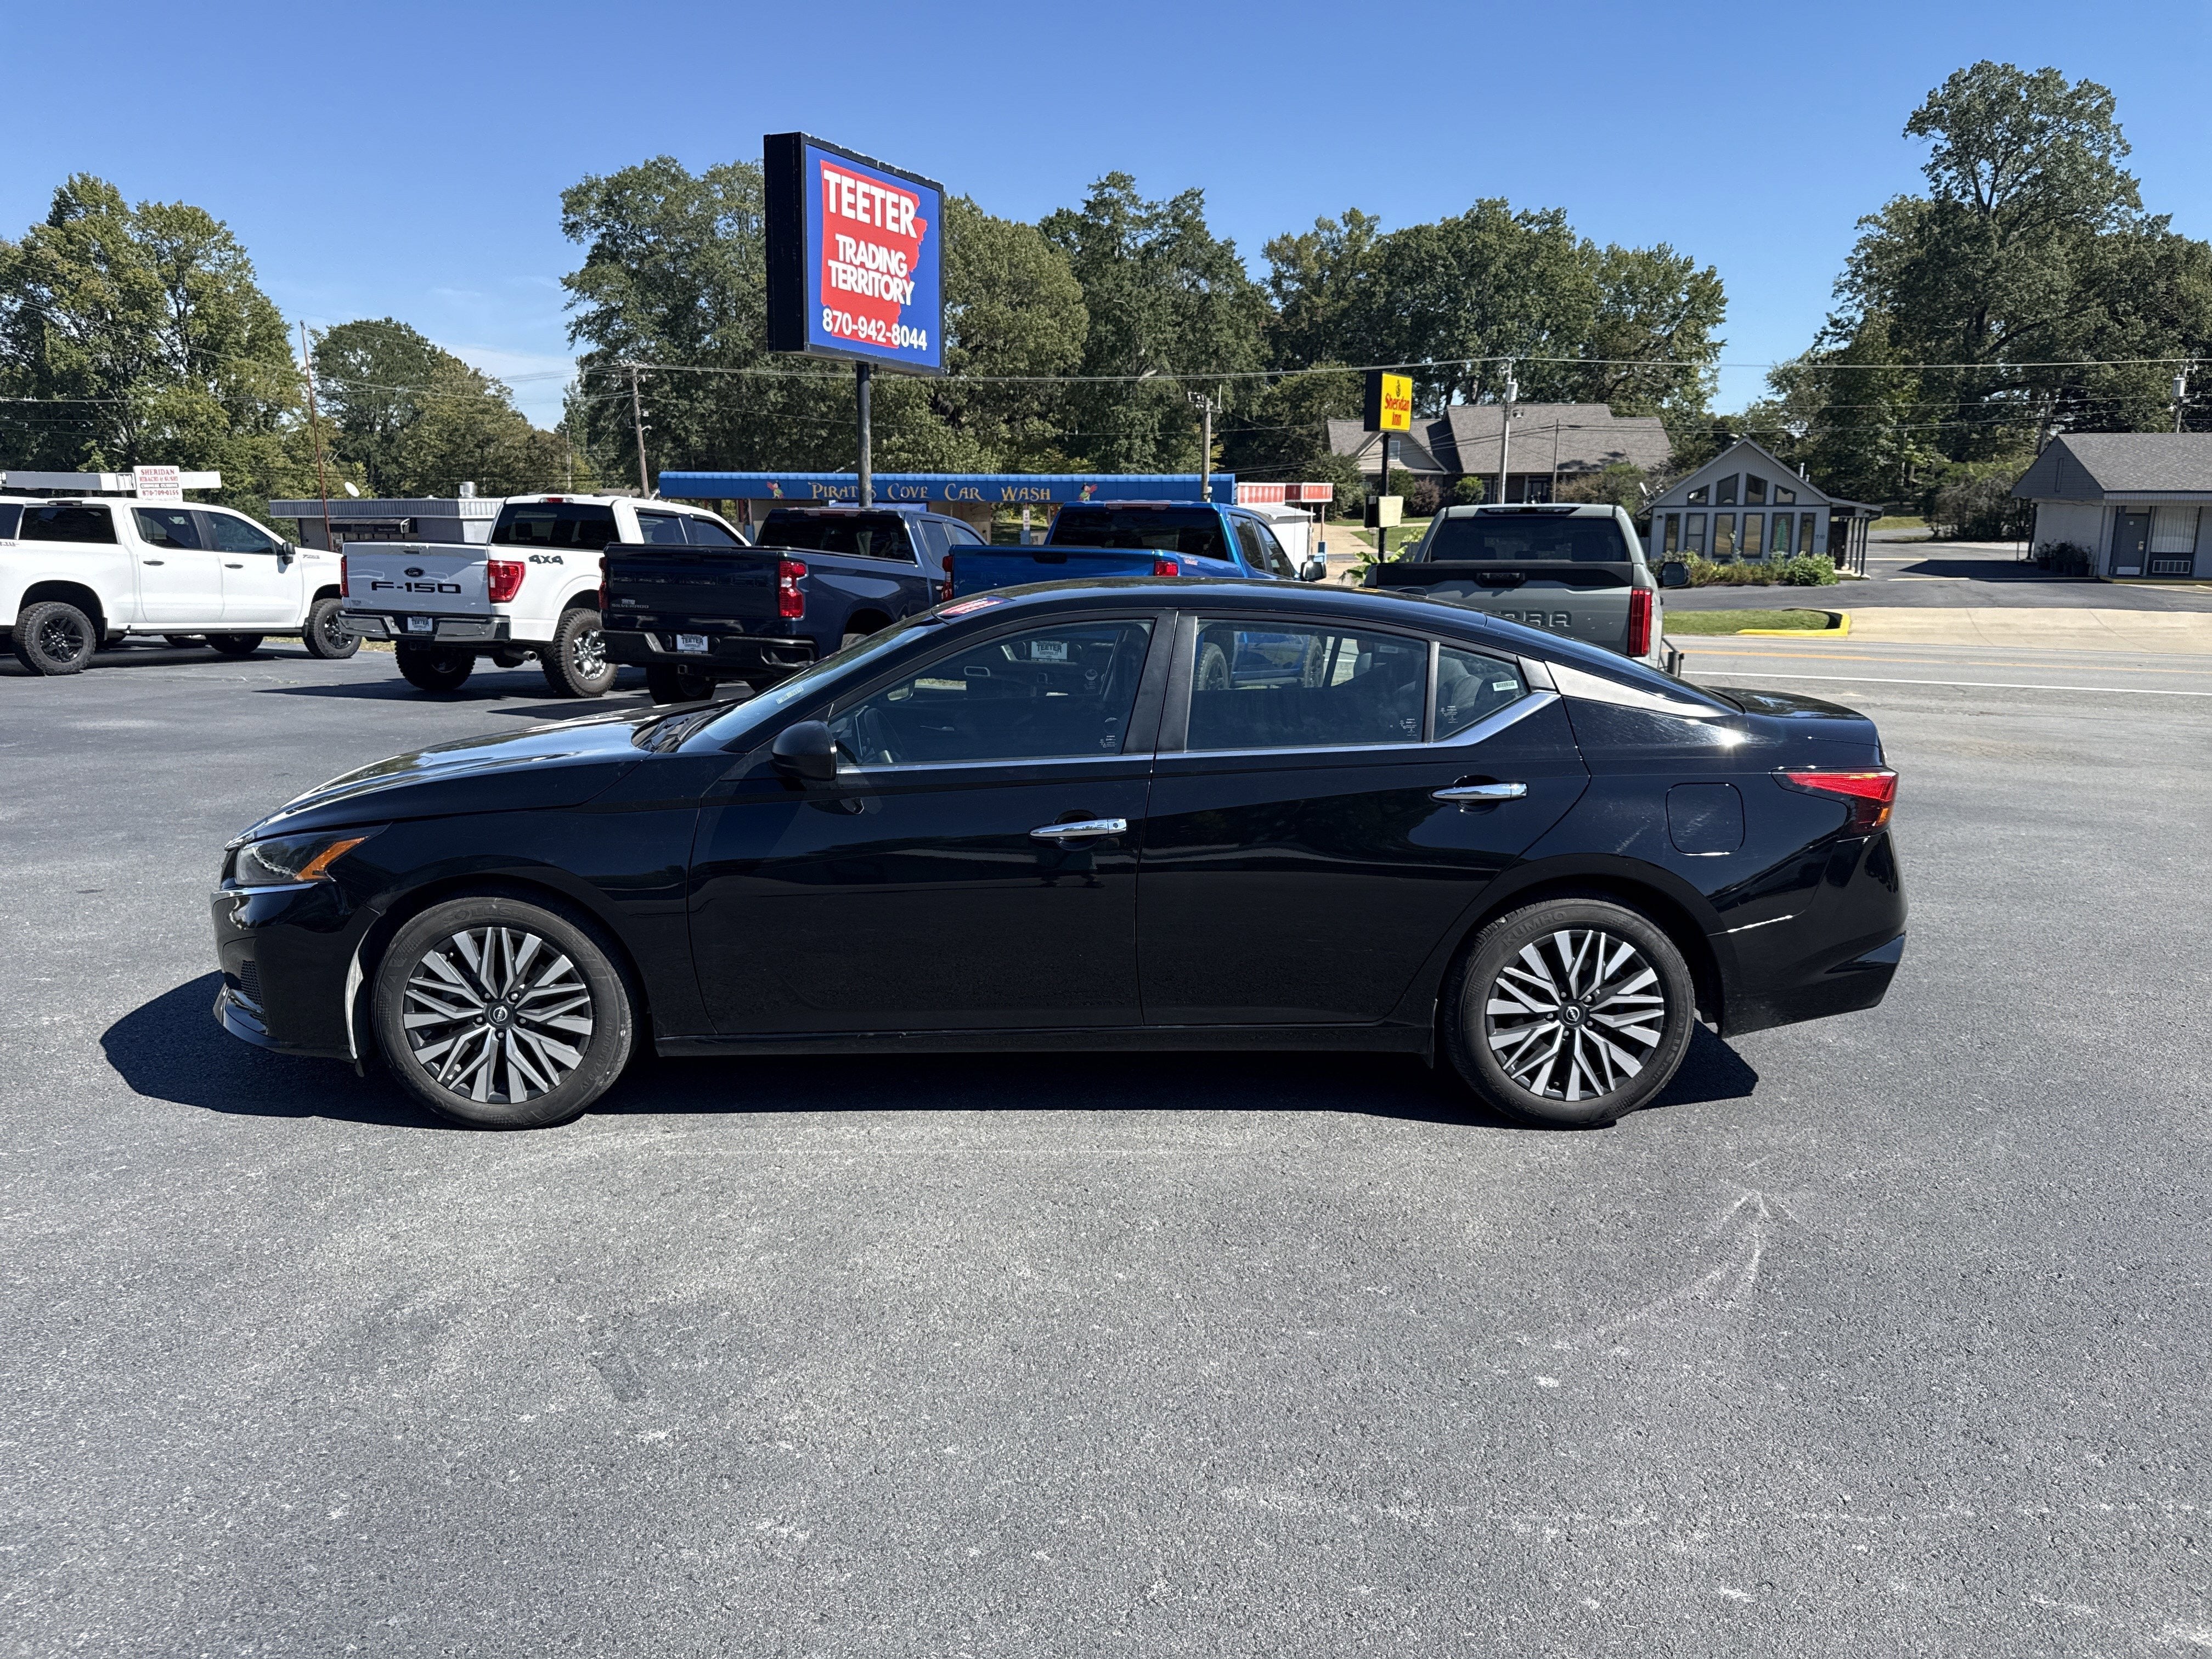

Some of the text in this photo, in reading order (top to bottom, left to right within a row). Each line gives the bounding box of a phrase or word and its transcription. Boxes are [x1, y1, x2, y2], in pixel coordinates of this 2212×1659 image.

[823, 169, 917, 238] TEETER
[835, 233, 908, 278] TRADING
[827, 259, 915, 306] TERRITORY
[822, 308, 927, 351] 870-942-8044
[1385, 392, 1410, 411] Sheridan
[808, 482, 1051, 501] PIRATS COVE CAR WASH
[371, 581, 461, 594] F-150
[682, 637, 704, 646] TEETER
[1037, 644, 1062, 653] TEETER
[1502, 911, 1567, 947] KUMHO
